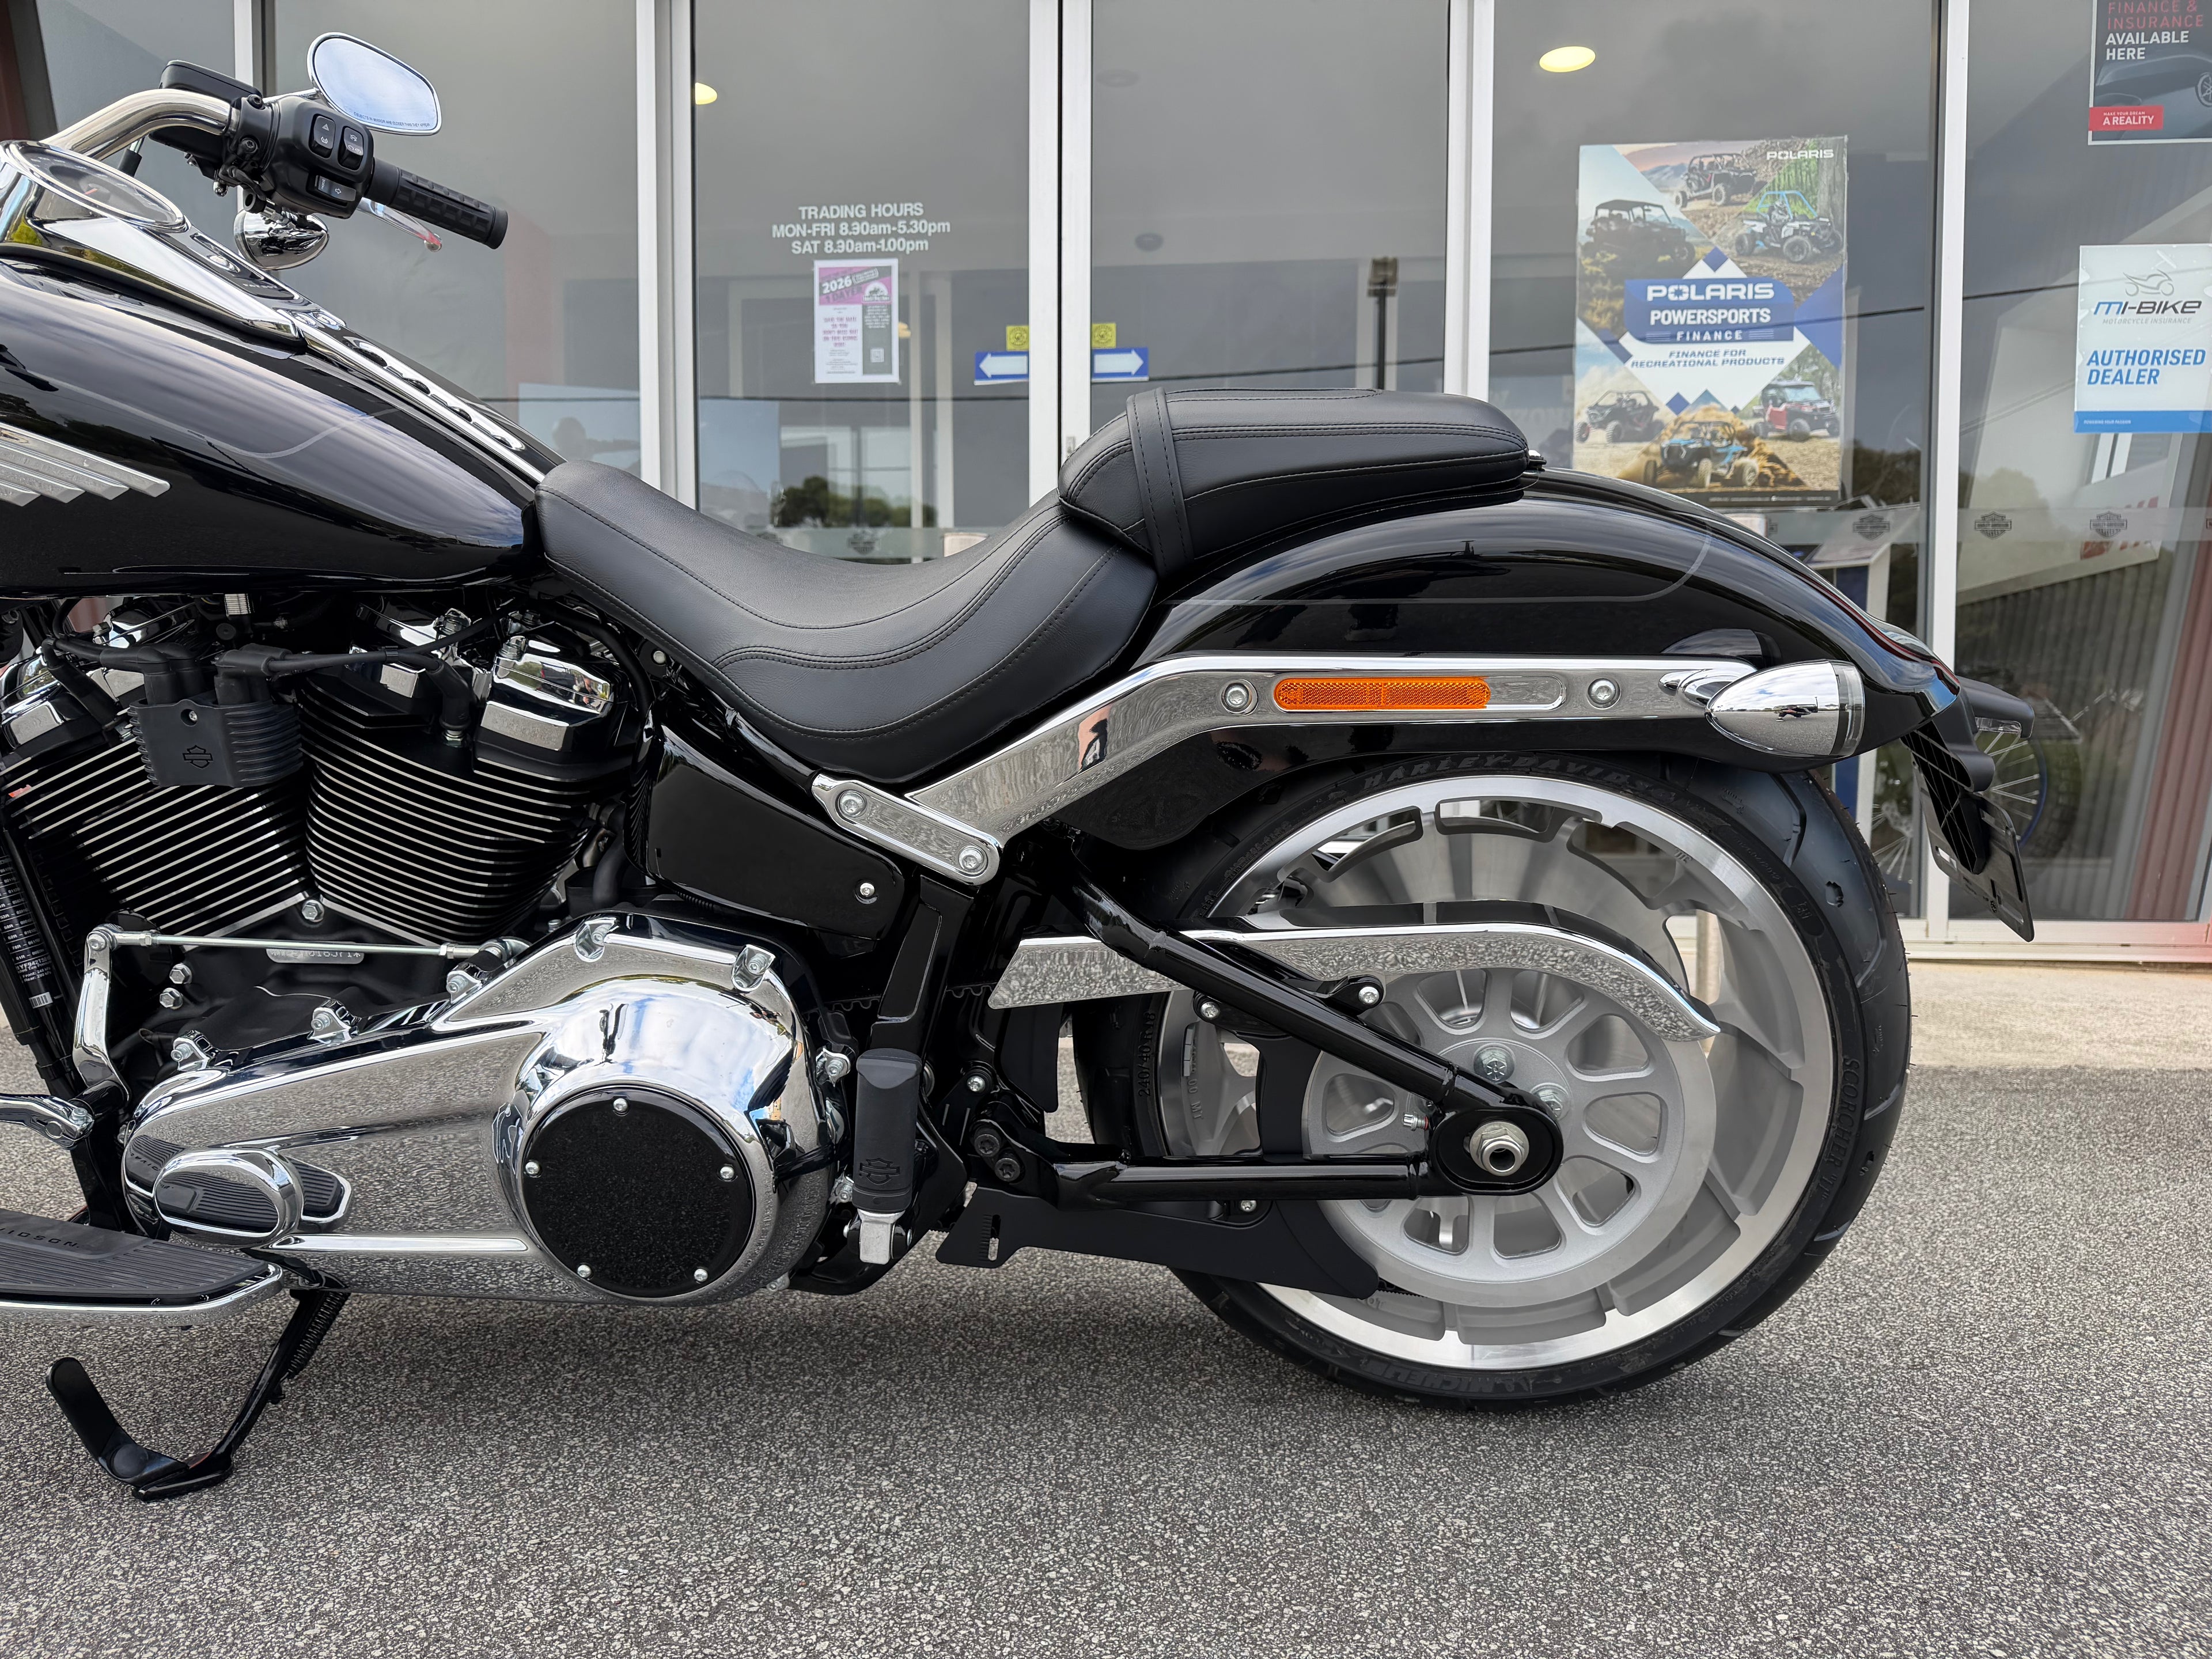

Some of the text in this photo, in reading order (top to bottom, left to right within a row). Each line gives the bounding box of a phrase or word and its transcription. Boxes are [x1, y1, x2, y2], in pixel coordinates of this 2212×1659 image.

[2108, 0, 2197, 14] FINANCE &
[2108, 14, 2203, 30] INSURANCE
[2105, 31, 2190, 45] AVAILABLE
[2106, 47, 2145, 60] HERE
[2103, 116, 2154, 125] A REALITY
[1767, 149, 1834, 160] POLARIS
[798, 203, 924, 219] TRADING HOURS
[772, 220, 950, 238] MON-FRI 8.30am-5.30pm
[791, 238, 929, 254] SAT 8.30am-1.00pm
[822, 275, 853, 294] 2026
[1647, 283, 1775, 301] POLARIS
[1650, 308, 1771, 325] POWERSPORTS
[1676, 330, 1743, 342] FINANCE
[1669, 350, 1721, 359] FINANCE
[2086, 349, 2206, 366] AUTHORISED
[1631, 357, 1785, 369] RECREATIONAL PRODUCTS
[2088, 369, 2160, 385] DEALER
[1138, 1042, 1152, 1097] 240/40
[1825, 1055, 1860, 1168] SCORCHER
